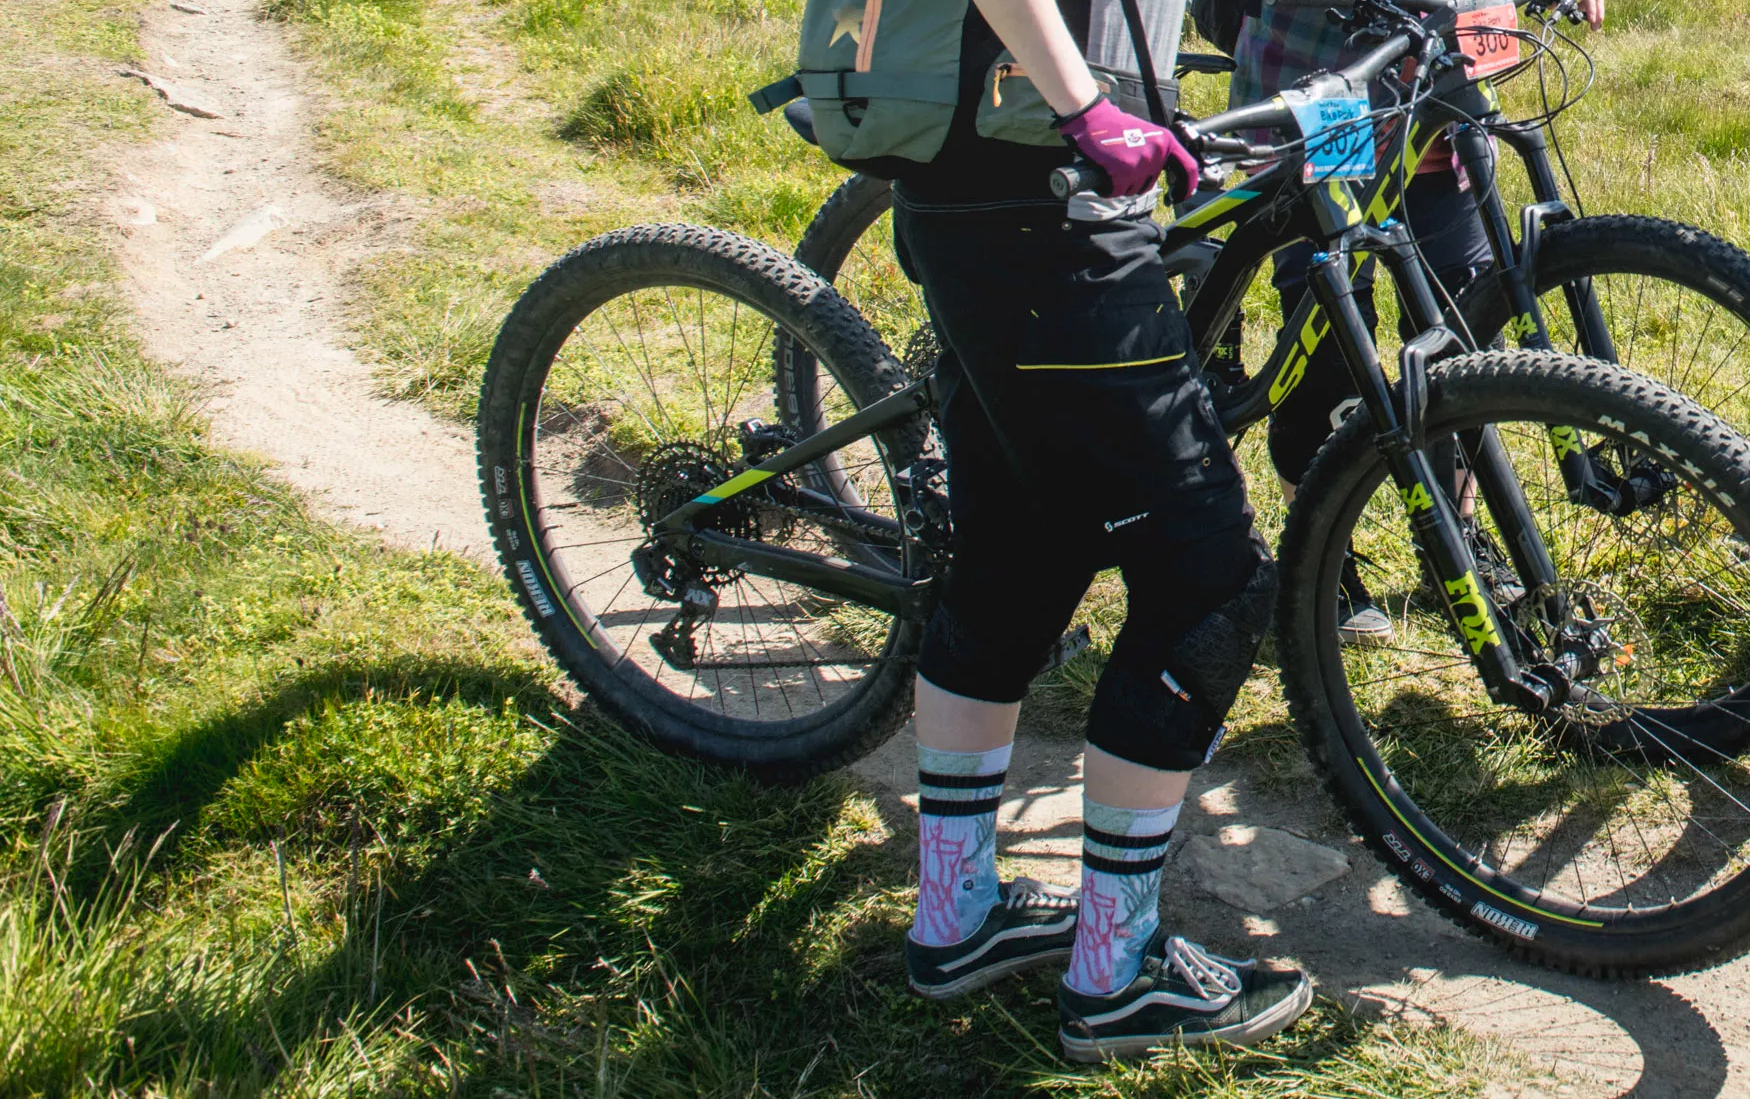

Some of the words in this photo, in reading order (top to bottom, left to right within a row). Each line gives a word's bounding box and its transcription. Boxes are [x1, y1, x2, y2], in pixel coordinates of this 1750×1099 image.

[1598, 415, 1736, 508] MAXXIS
[1114, 511, 1150, 528] SCOTT
[515, 559, 556, 619] REKON
[1444, 569, 1501, 655] FOX
[1411, 861, 1432, 881] EXO
[1470, 900, 1539, 940] REKON
